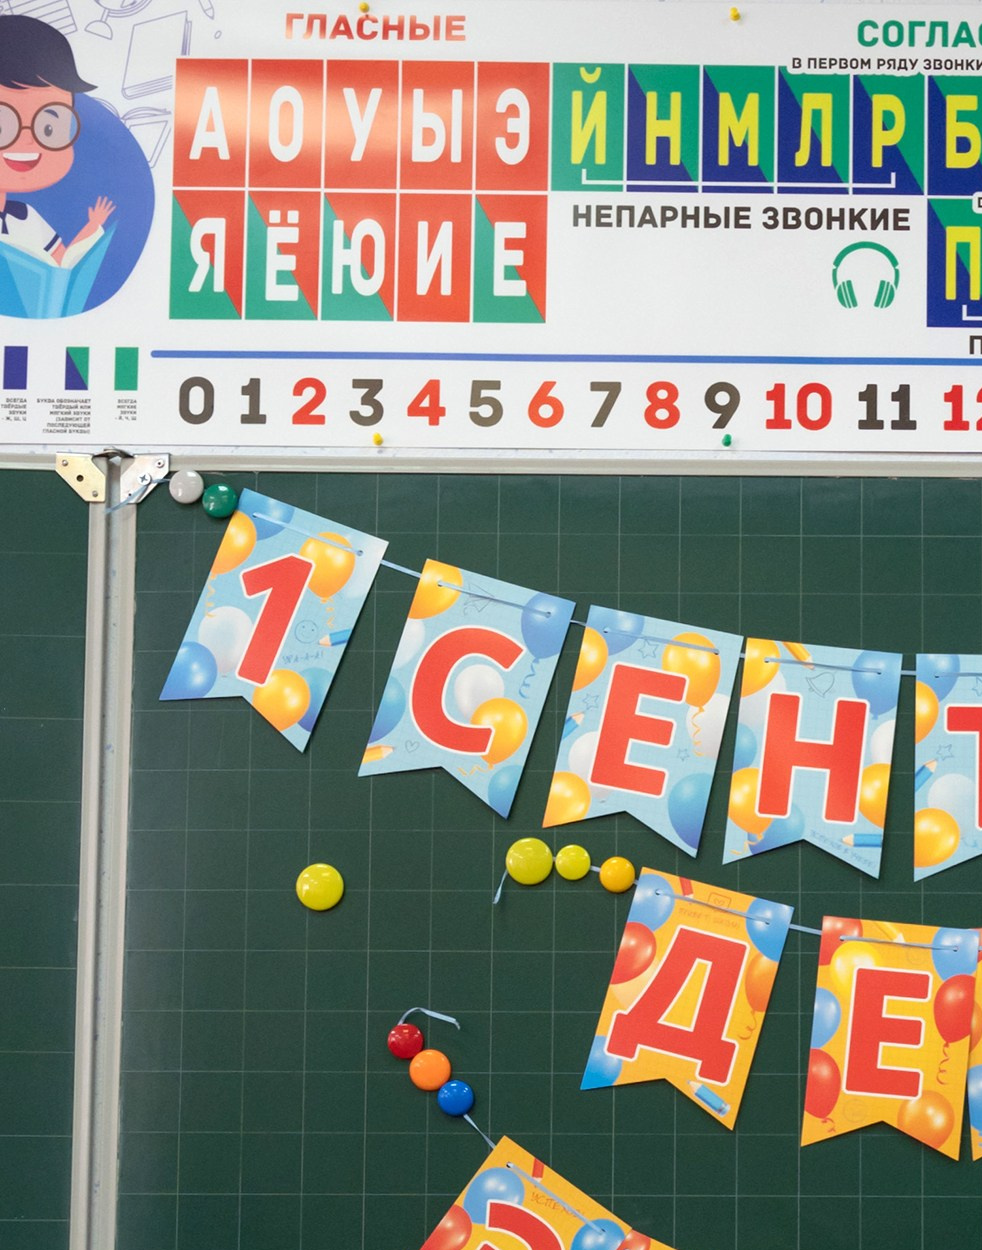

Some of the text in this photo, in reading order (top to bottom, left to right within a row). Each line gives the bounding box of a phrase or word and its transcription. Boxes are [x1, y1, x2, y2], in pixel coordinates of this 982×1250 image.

[285, 13, 466, 41] ГЛАСНЫЕ
[793, 58, 801, 68] В
[808, 58, 870, 69] ПЕРВОМ
[877, 58, 918, 73] РЯДУ
[189, 85, 530, 165] А О У Ы Э
[571, 67, 606, 164] Й
[646, 92, 681, 165] Н
[719, 93, 758, 166] М
[795, 94, 832, 166] Л
[872, 95, 905, 167] Р
[946, 96, 981, 168] Б
[573, 205, 910, 230] НЕПАРНЫЕ ЗВОНКИЕ
[189, 210, 526, 301] Я Ё Ю И Е
[946, 227, 980, 300] П
[179, 377, 214, 424] 0
[241, 378, 266, 424] 1
[292, 378, 326, 425] 2
[350, 379, 383, 426] 3
[408, 380, 445, 426] 4
[469, 380, 503, 427] 5
[528, 381, 564, 428] 6
[590, 382, 621, 427] 7
[644, 382, 680, 429] 8
[705, 382, 740, 429] 9
[766, 383, 832, 430] 10
[858, 384, 916, 430] 11
[239, 553, 314, 687] 1
